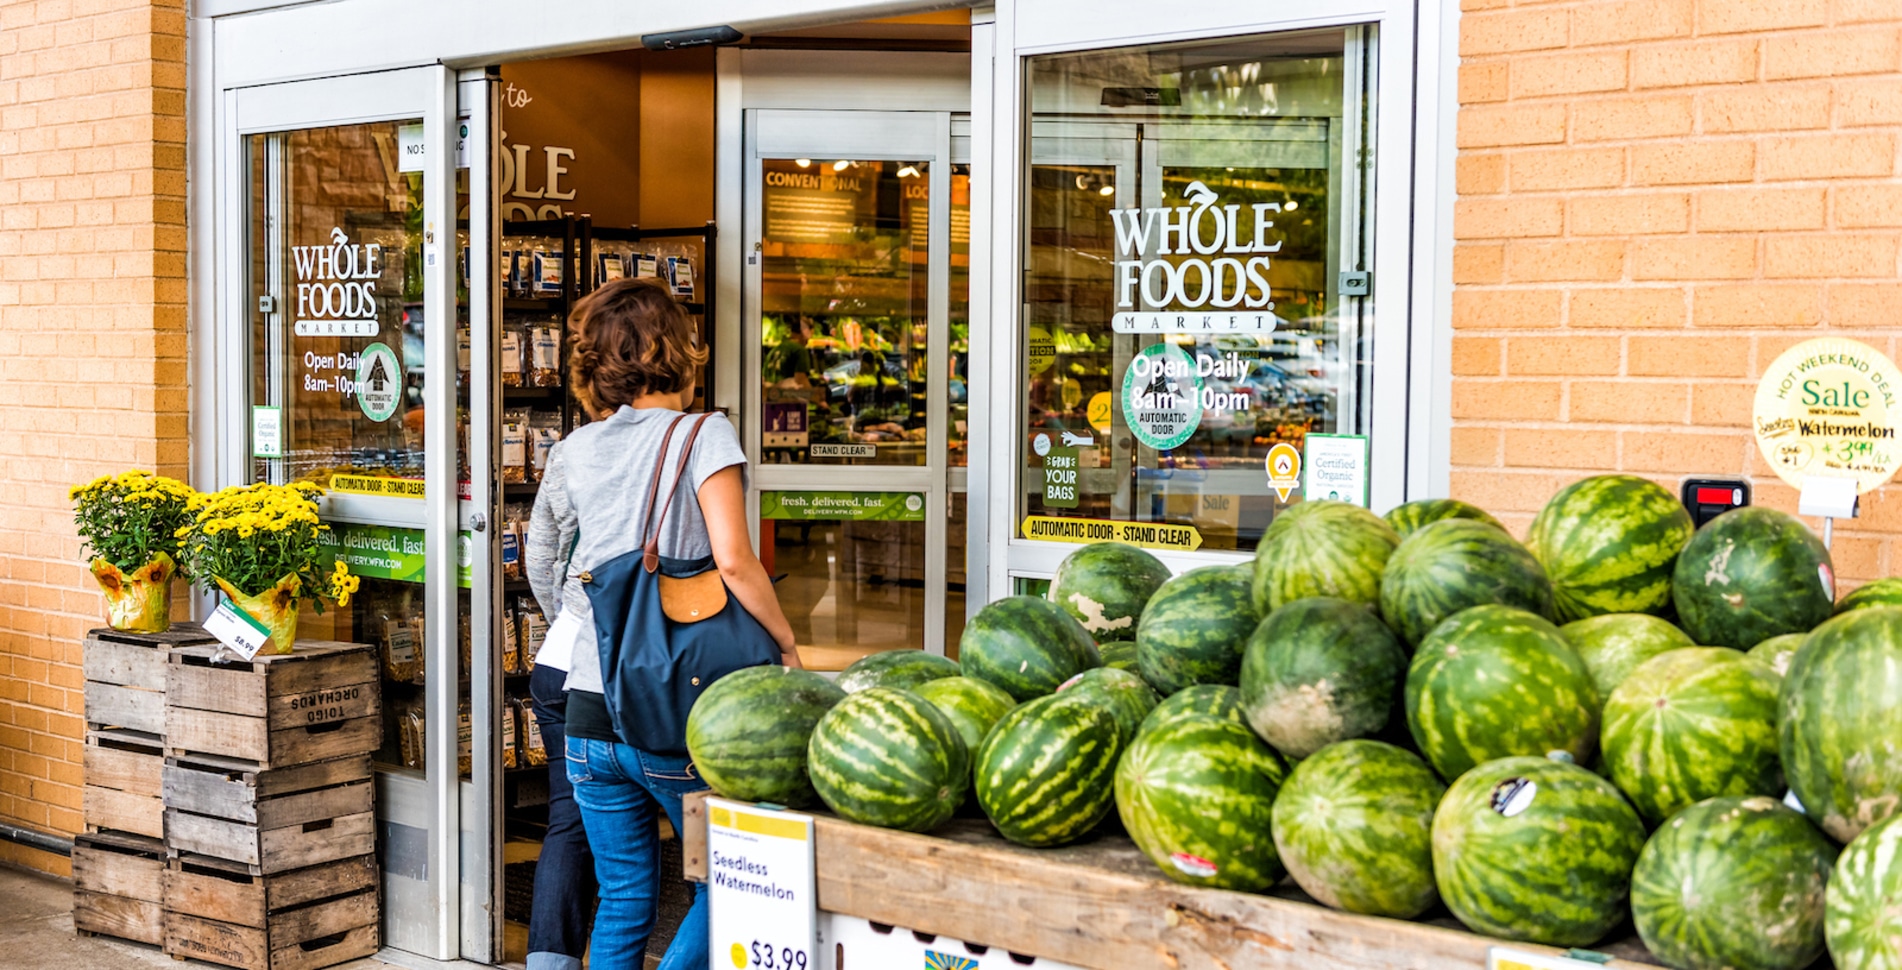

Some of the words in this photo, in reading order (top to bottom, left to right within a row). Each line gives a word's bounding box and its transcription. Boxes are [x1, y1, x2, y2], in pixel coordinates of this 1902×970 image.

[505, 82, 533, 108] to
[407, 144, 419, 154] NO
[1109, 181, 1282, 256] WHOLE
[291, 227, 382, 281] WHOLE
[1118, 256, 1272, 308] FOODS
[297, 281, 377, 318] FOODS
[301, 323, 372, 333] MARKET
[1124, 316, 1264, 329] MARKET
[1029, 346, 1055, 355] TION
[304, 351, 334, 373] Open
[337, 352, 366, 376] Daily
[1132, 354, 1189, 385] Open
[1196, 352, 1250, 384] Daily
[1776, 371, 1797, 400] HOT
[1796, 353, 1870, 373] WEEKEND
[1870, 372, 1896, 409] DEAL
[364, 394, 392, 402] AUTOMATIC
[1801, 379, 1870, 409] Sale
[372, 402, 385, 411] DOOR
[1139, 413, 1188, 423] AUTOMATIC
[1151, 424, 1174, 434] DOOR
[1797, 418, 1895, 439] Watermelon
[812, 446, 838, 455] STAND
[840, 446, 866, 455] CLEAR
[1051, 456, 1070, 468] GRAB
[1315, 457, 1356, 469] Certified
[1045, 469, 1077, 484] YOUR
[1317, 469, 1354, 482] Organic
[334, 477, 366, 490] AUTOMATIC
[367, 479, 382, 491] DOOR
[387, 482, 406, 494] STAND
[1047, 485, 1074, 500] BAGS
[781, 496, 809, 506] fresh.
[811, 496, 861, 507] delivered.
[864, 497, 885, 507] fast.
[1202, 494, 1230, 510] Sale
[317, 529, 341, 546] esh.
[344, 531, 400, 553] delivered.
[1031, 520, 1085, 538] AUTOMATIC
[1087, 523, 1114, 540] DOOR
[1122, 526, 1155, 543] STAND
[1158, 529, 1191, 546] CLEAR
[334, 553, 402, 570] DELIVERY.WFM.COM
[234, 635, 255, 652] $8.99
[291, 688, 359, 710] ORCHARDS
[307, 706, 345, 722] TOIGO
[713, 850, 768, 876] Seedless
[713, 870, 794, 901] Watermelon
[751, 939, 807, 970] $3.99
